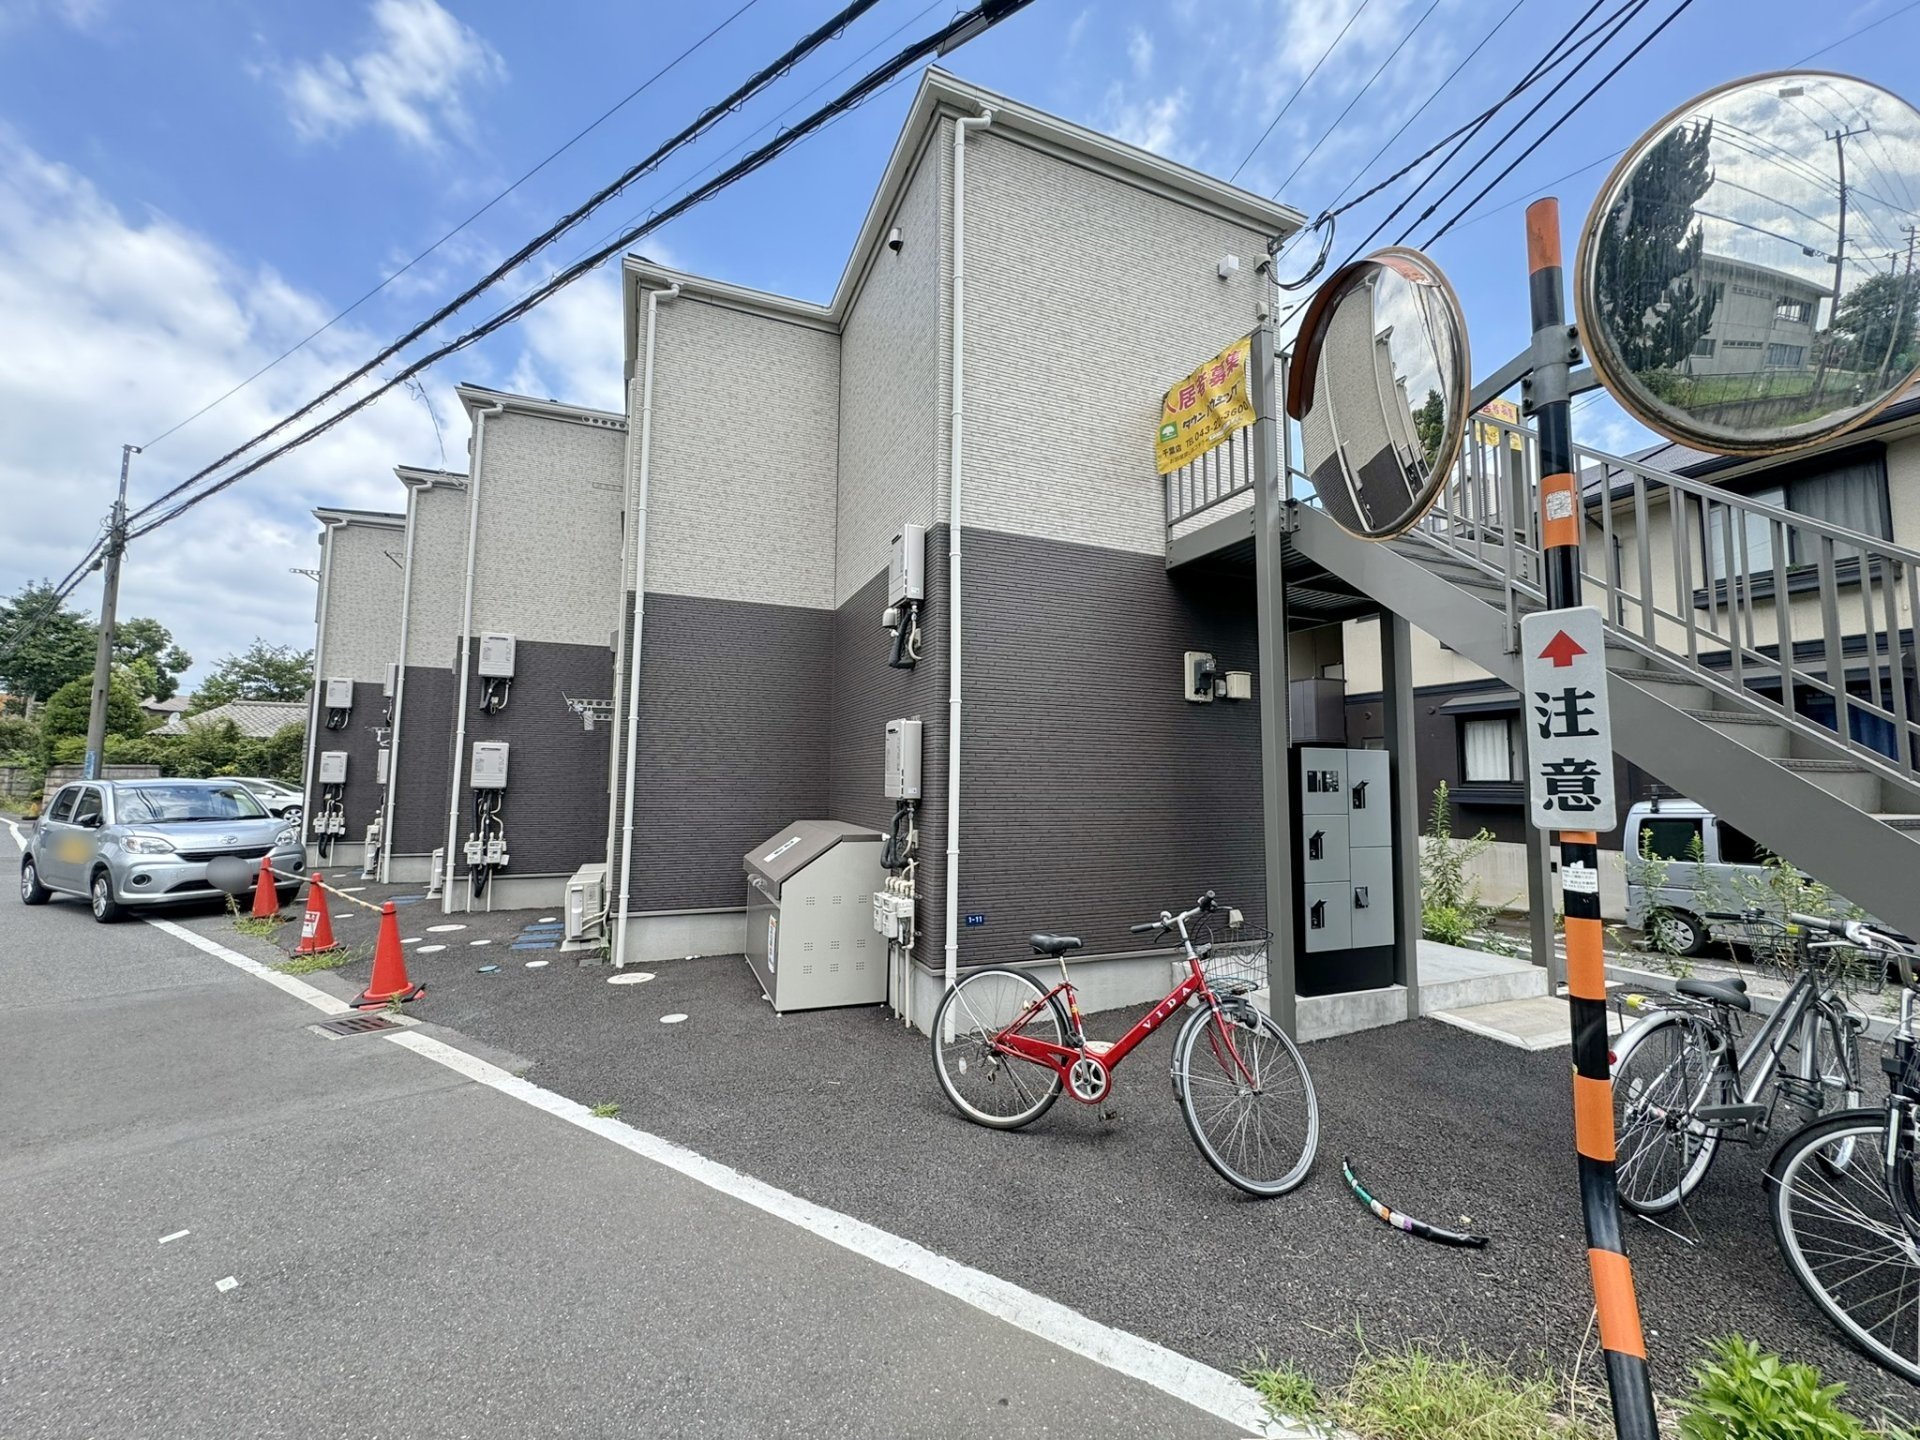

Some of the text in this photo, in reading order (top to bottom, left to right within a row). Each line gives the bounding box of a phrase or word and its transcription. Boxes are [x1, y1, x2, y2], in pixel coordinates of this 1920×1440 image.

[1194, 401, 1249, 441] 043-2-3600
[1534, 687, 1602, 812] 注意
[968, 915, 983, 923] 1-11
[1142, 987, 1192, 1029] VIDA
